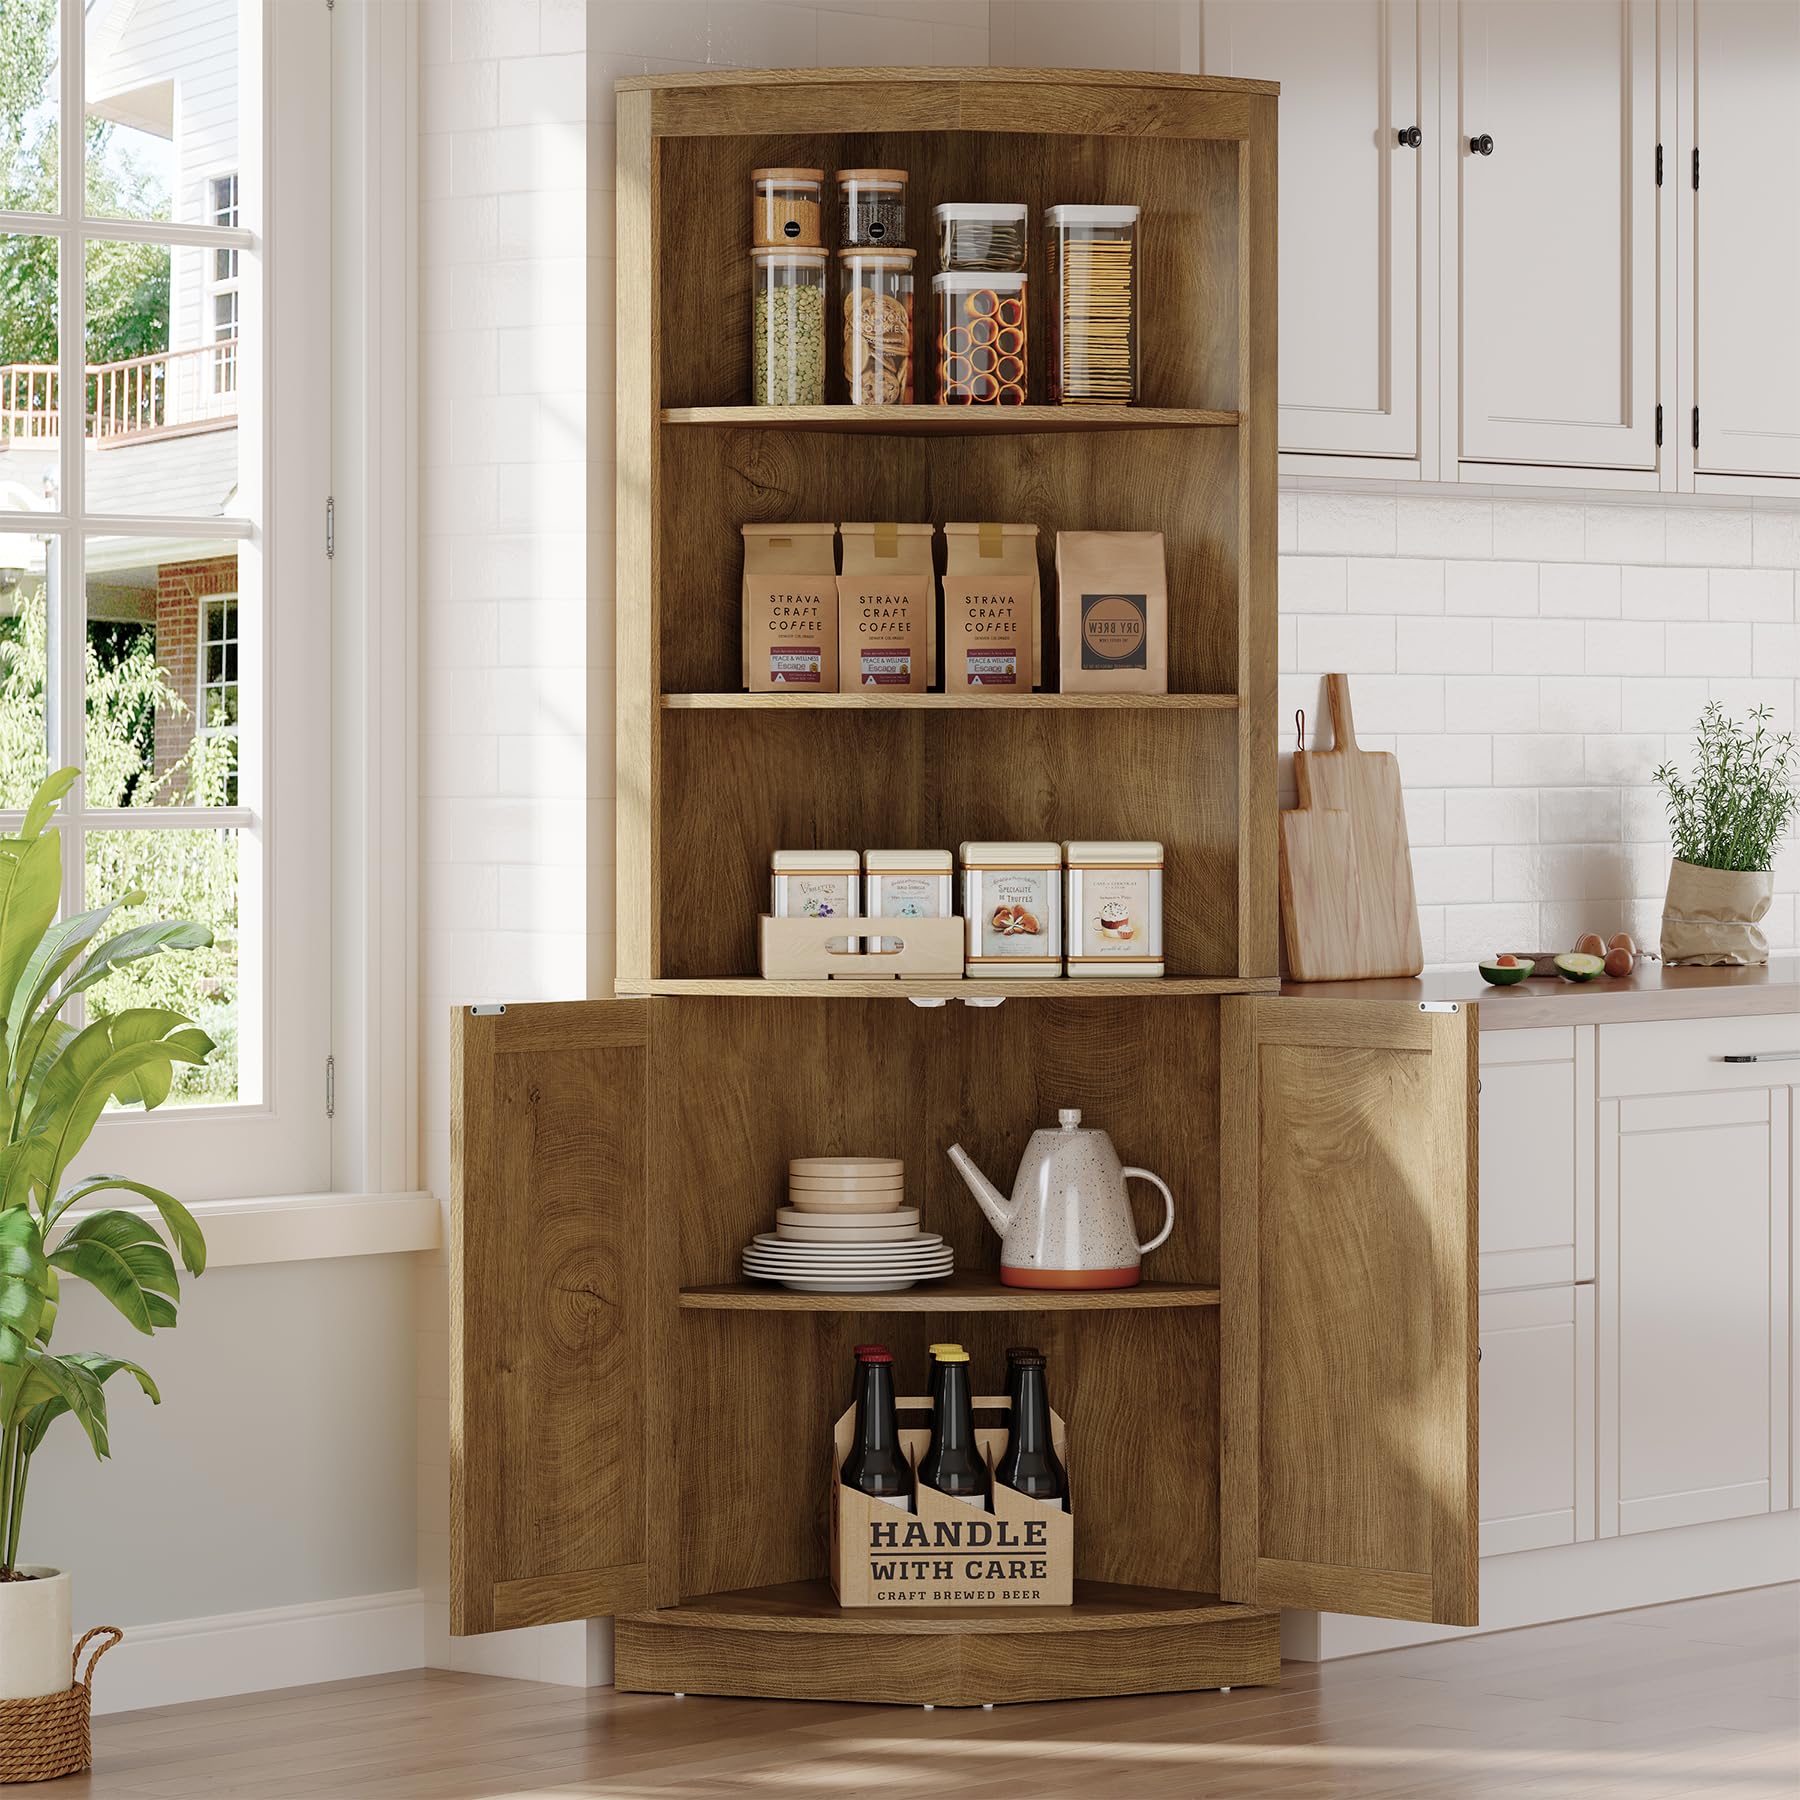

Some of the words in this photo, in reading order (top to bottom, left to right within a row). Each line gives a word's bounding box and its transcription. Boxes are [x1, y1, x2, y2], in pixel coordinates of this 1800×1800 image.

[770, 594, 820, 603] STRAVA
[859, 595, 909, 604] STRAVA
[965, 596, 1015, 604] STRAVA
[773, 607, 817, 616] CRAFT
[863, 608, 907, 617] CRAFT
[969, 608, 1012, 617] CRAFT
[769, 621, 822, 631] COFFEE
[859, 622, 911, 632] COFFEE
[965, 622, 1017, 632] COFFEE
[778, 662, 806, 671] Escape
[868, 664, 897, 673] Escape
[974, 664, 1003, 673] Escape
[870, 1521, 1047, 1547] HANDLE
[871, 1561, 953, 1580] WITH
[965, 1560, 1047, 1579] CARE
[877, 1591, 927, 1600] CRAFT
[933, 1590, 995, 1600] BREWED
[1002, 1590, 1041, 1600] BEER
